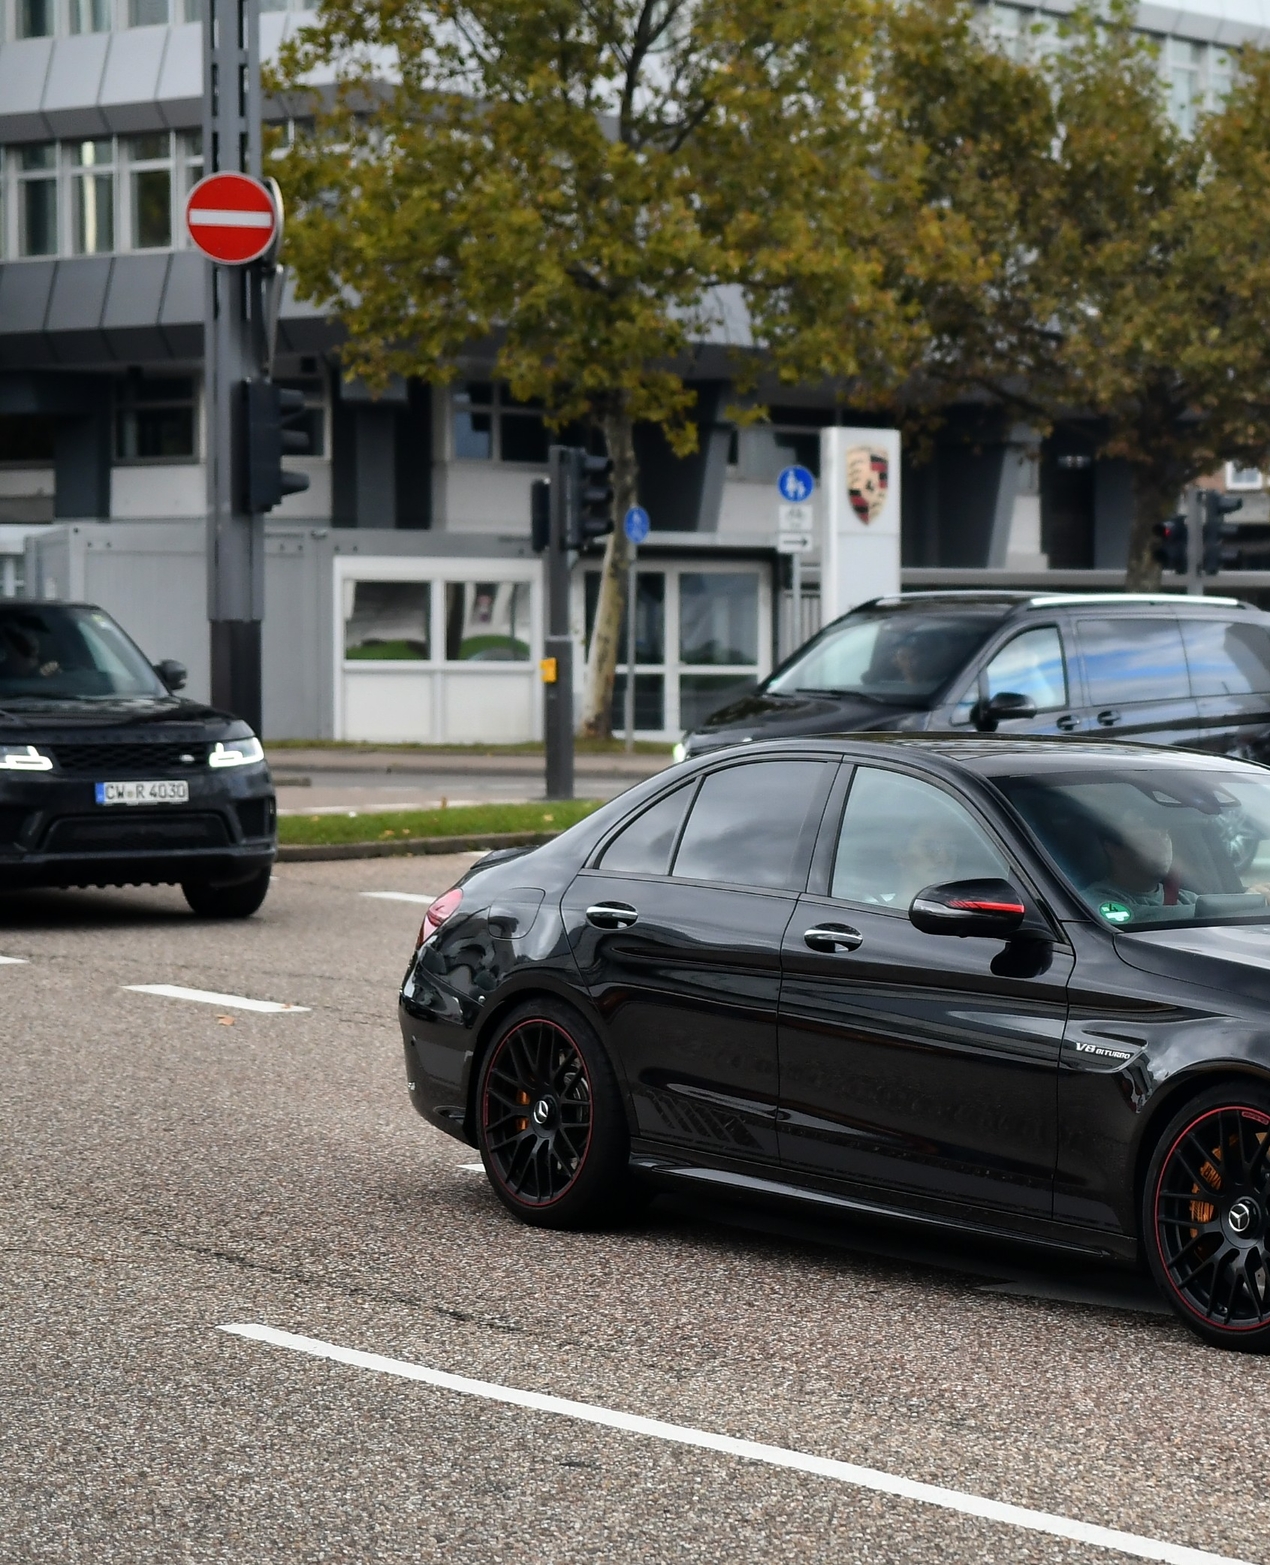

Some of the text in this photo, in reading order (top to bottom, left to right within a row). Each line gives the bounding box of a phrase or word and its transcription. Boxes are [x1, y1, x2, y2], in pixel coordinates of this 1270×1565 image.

[105, 783, 186, 799] CW R 4030
[1076, 1042, 1131, 1059] V8 BITURBO
